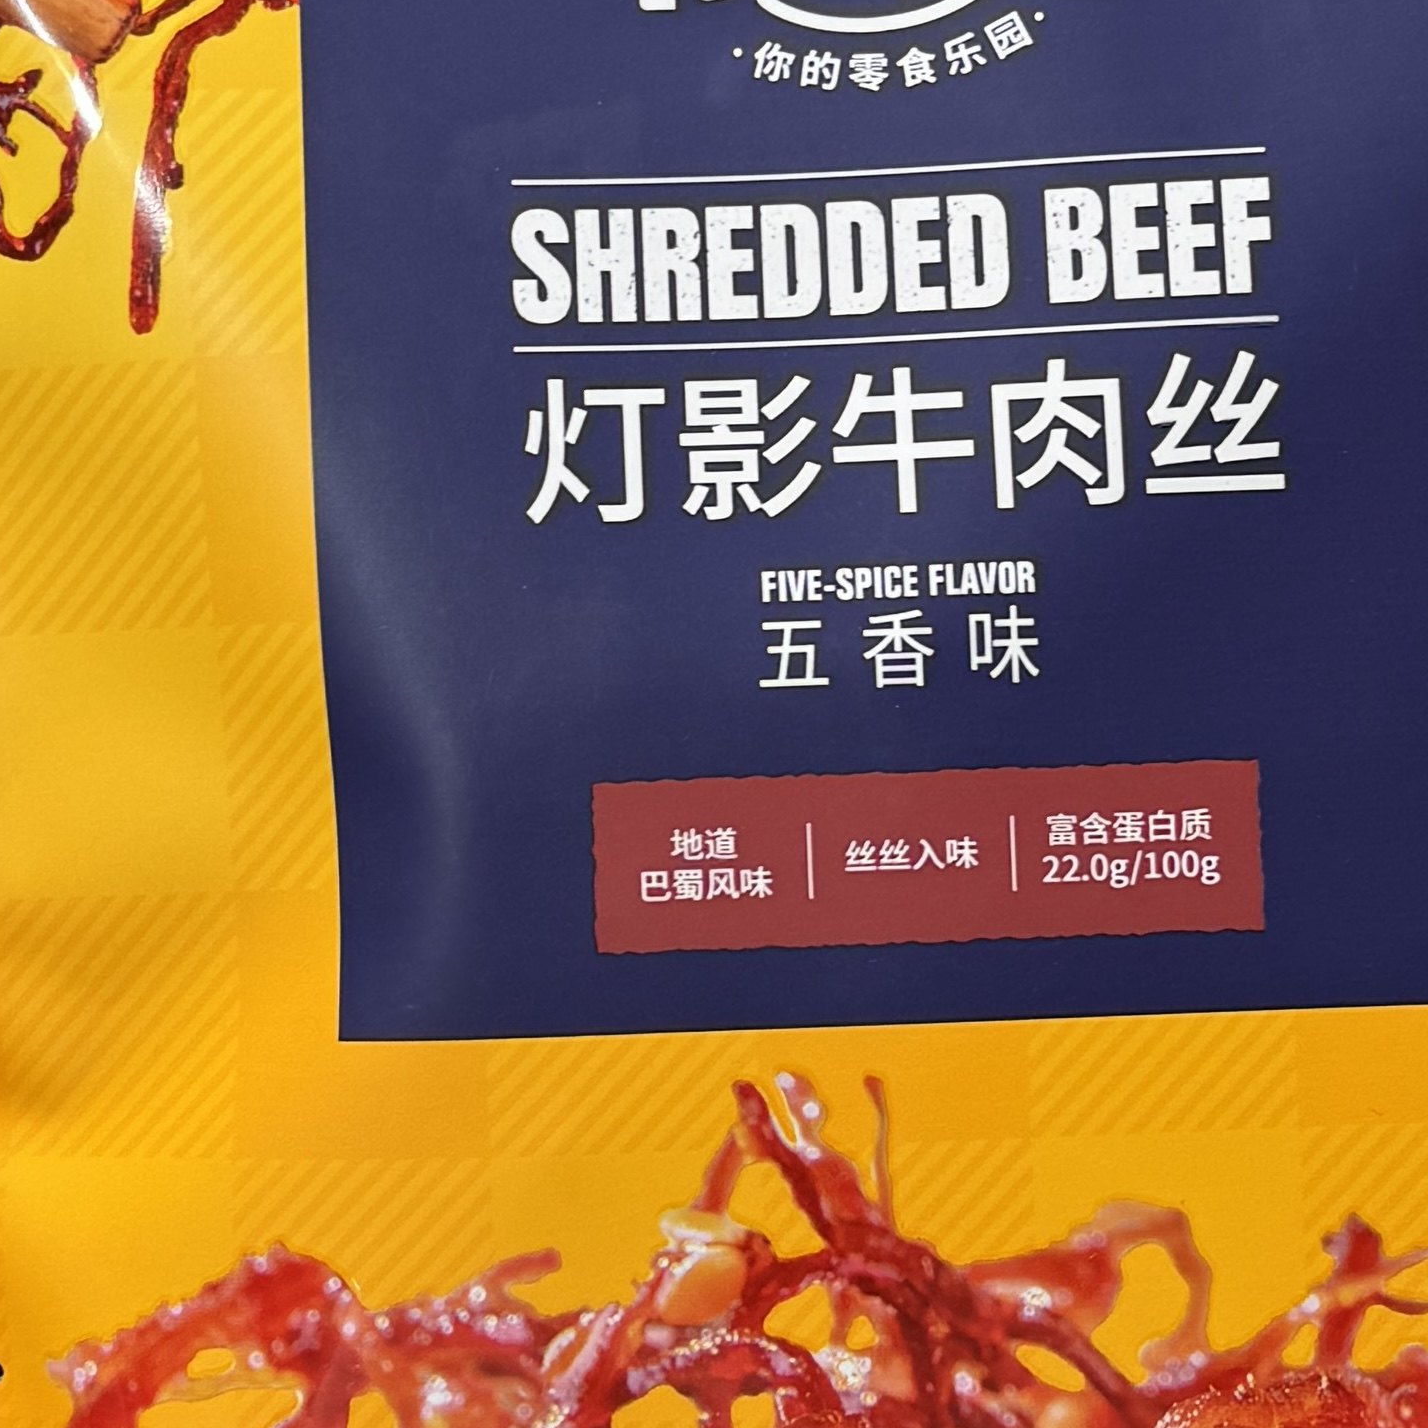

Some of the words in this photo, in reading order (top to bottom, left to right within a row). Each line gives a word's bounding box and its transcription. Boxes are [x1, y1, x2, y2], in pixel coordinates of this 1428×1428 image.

[510, 192, 1011, 325] SHREDDED
[1043, 176, 1272, 304] BEEF
[524, 350, 1286, 525] 灯影牛肉丝
[760, 564, 920, 603] FIVE-SPICE
[928, 560, 1036, 597] FLAVOR
[758, 604, 1040, 689] 五香味
[669, 827, 738, 861] 地道
[1046, 808, 1212, 846] 富含蛋白质
[844, 835, 979, 872] 丝丝入味
[1042, 849, 1221, 889] 22.0g/100g
[640, 865, 773, 902] 巴蜀风味
